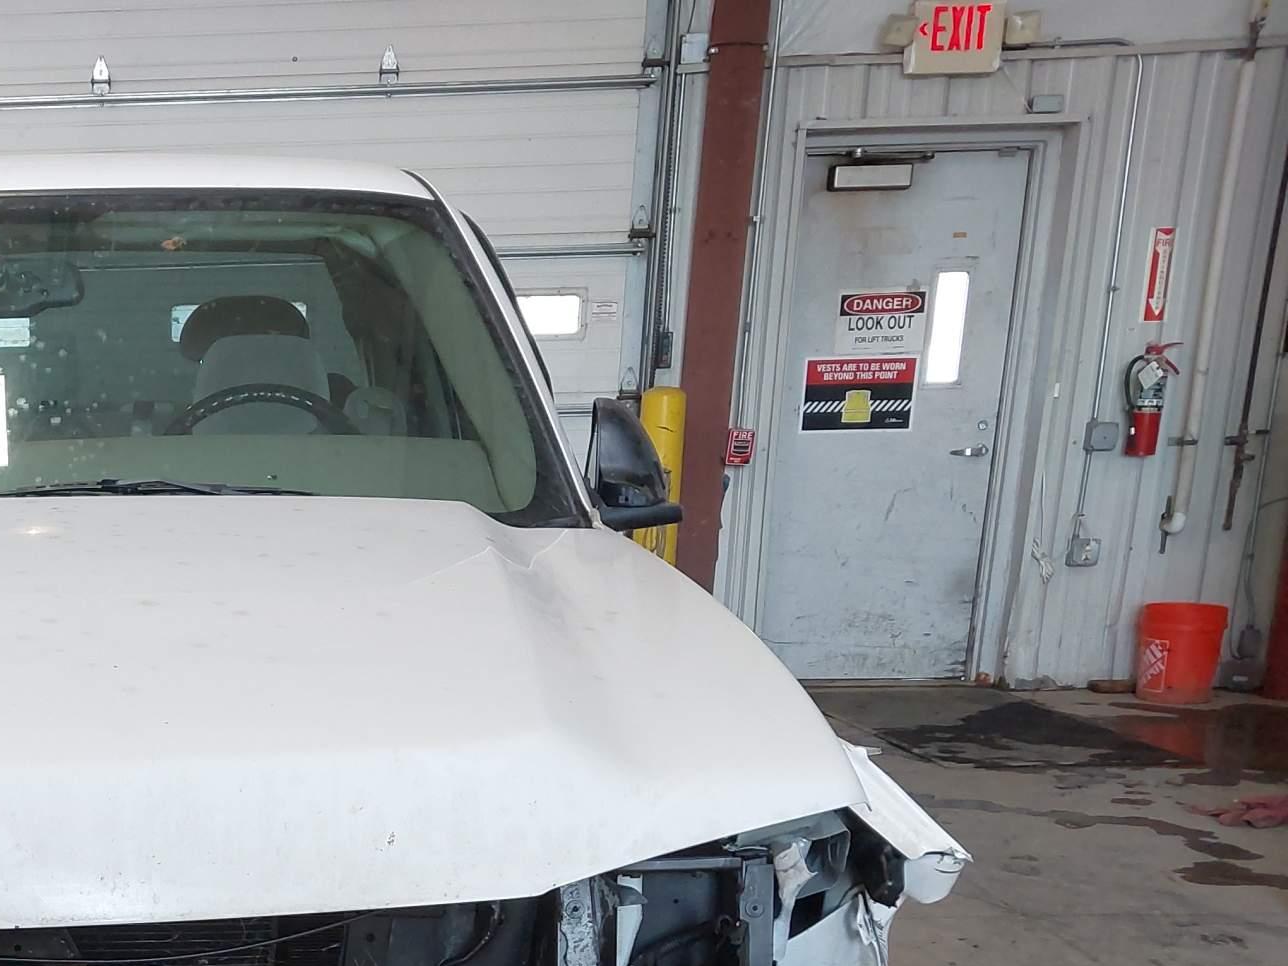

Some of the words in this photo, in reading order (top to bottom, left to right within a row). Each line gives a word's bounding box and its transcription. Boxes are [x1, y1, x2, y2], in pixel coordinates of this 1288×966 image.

[930, 5, 992, 51] EXIT
[853, 298, 913, 311] DANGER
[848, 316, 884, 331] LOOK
[887, 315, 914, 329] OUT
[854, 336, 867, 344] FOR
[881, 335, 904, 343] TRUCKS
[817, 364, 841, 372] VESTS
[842, 363, 858, 371] ARE
[859, 363, 869, 371] TO
[871, 363, 881, 371] BE
[882, 362, 907, 370] WORN
[823, 372, 854, 380] BEYOND
[856, 371, 873, 379] THIS
[874, 371, 898, 379] POINT
[733, 431, 753, 439] FIRE
